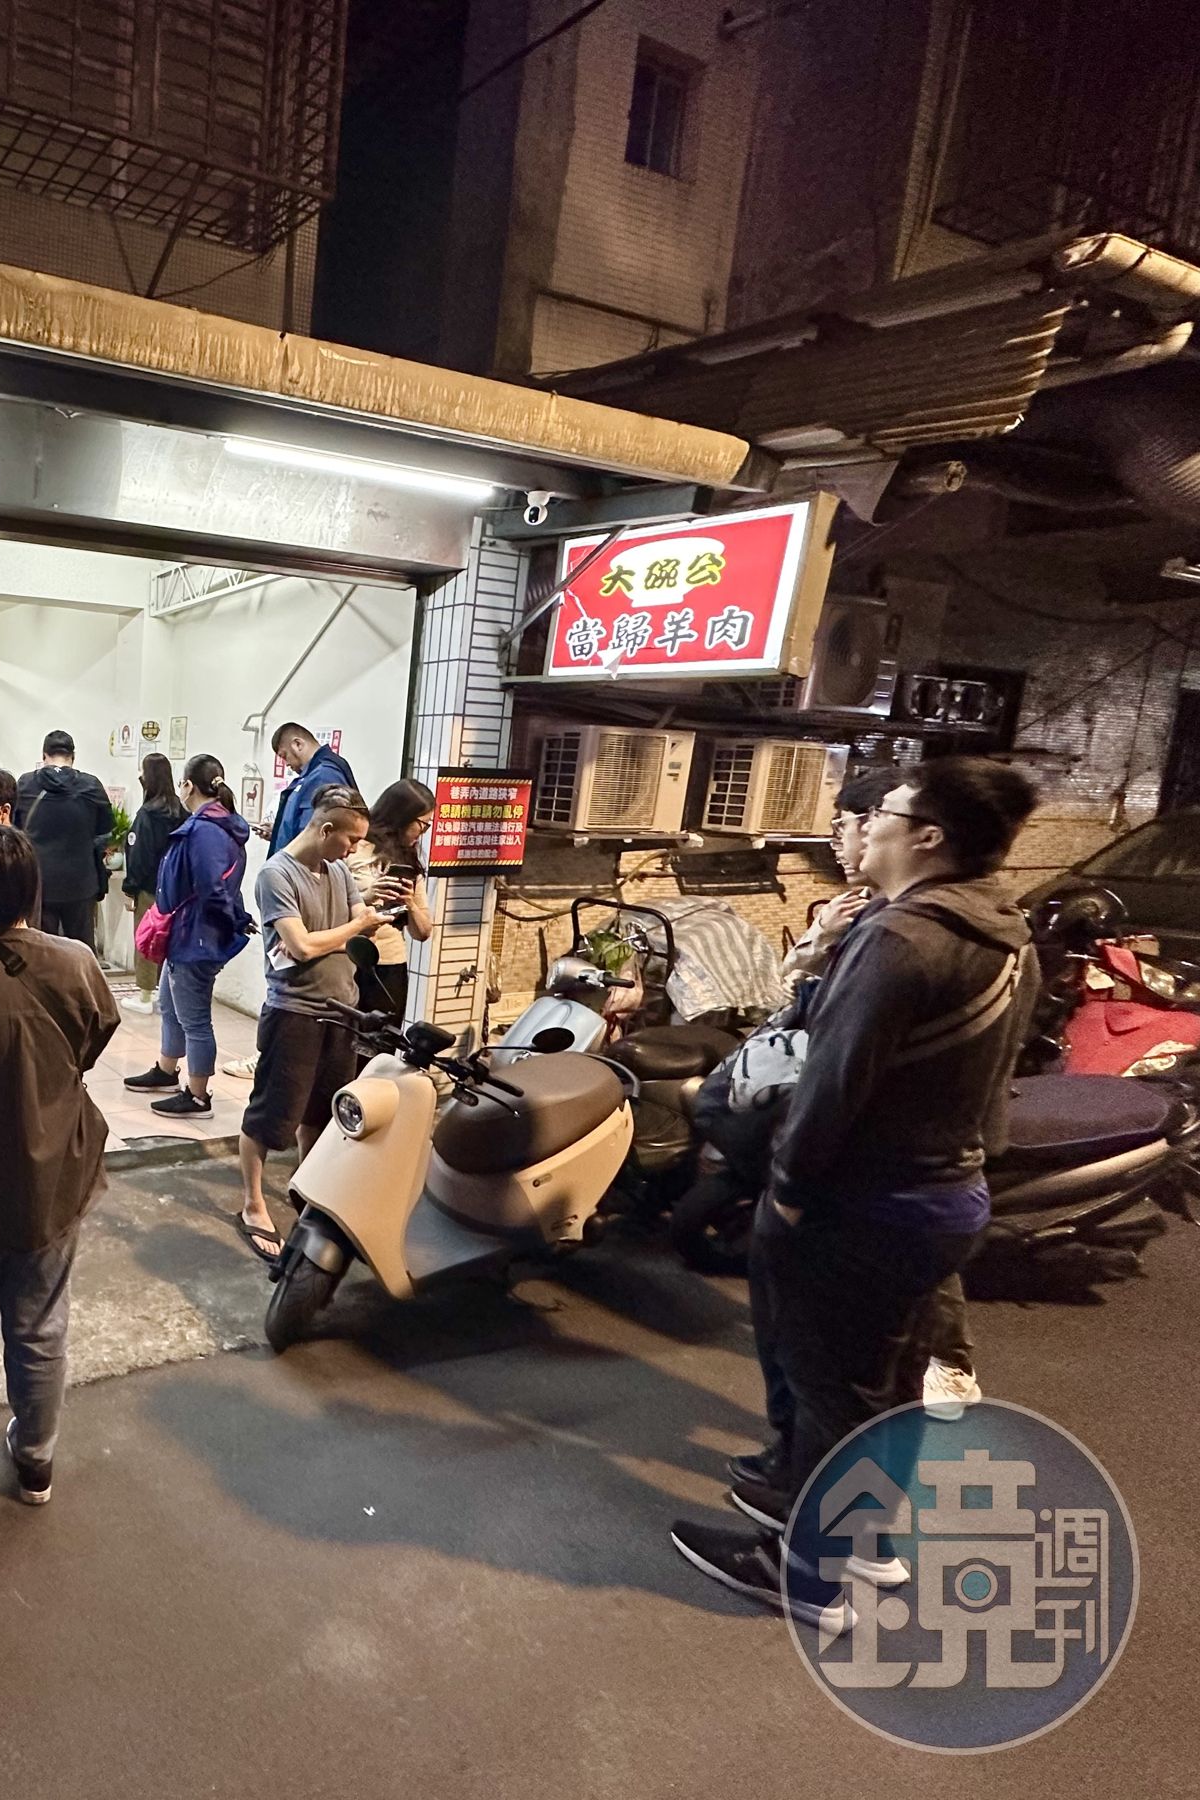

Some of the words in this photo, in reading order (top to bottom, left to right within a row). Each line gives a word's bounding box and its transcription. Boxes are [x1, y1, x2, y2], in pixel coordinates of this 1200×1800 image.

[600, 551, 726, 596] 大碗公
[566, 605, 754, 661] 當歸羊肉
[450, 786, 518, 801] 巷弄內道路狹窄
[439, 804, 524, 819] 懇請機車請勿亂停
